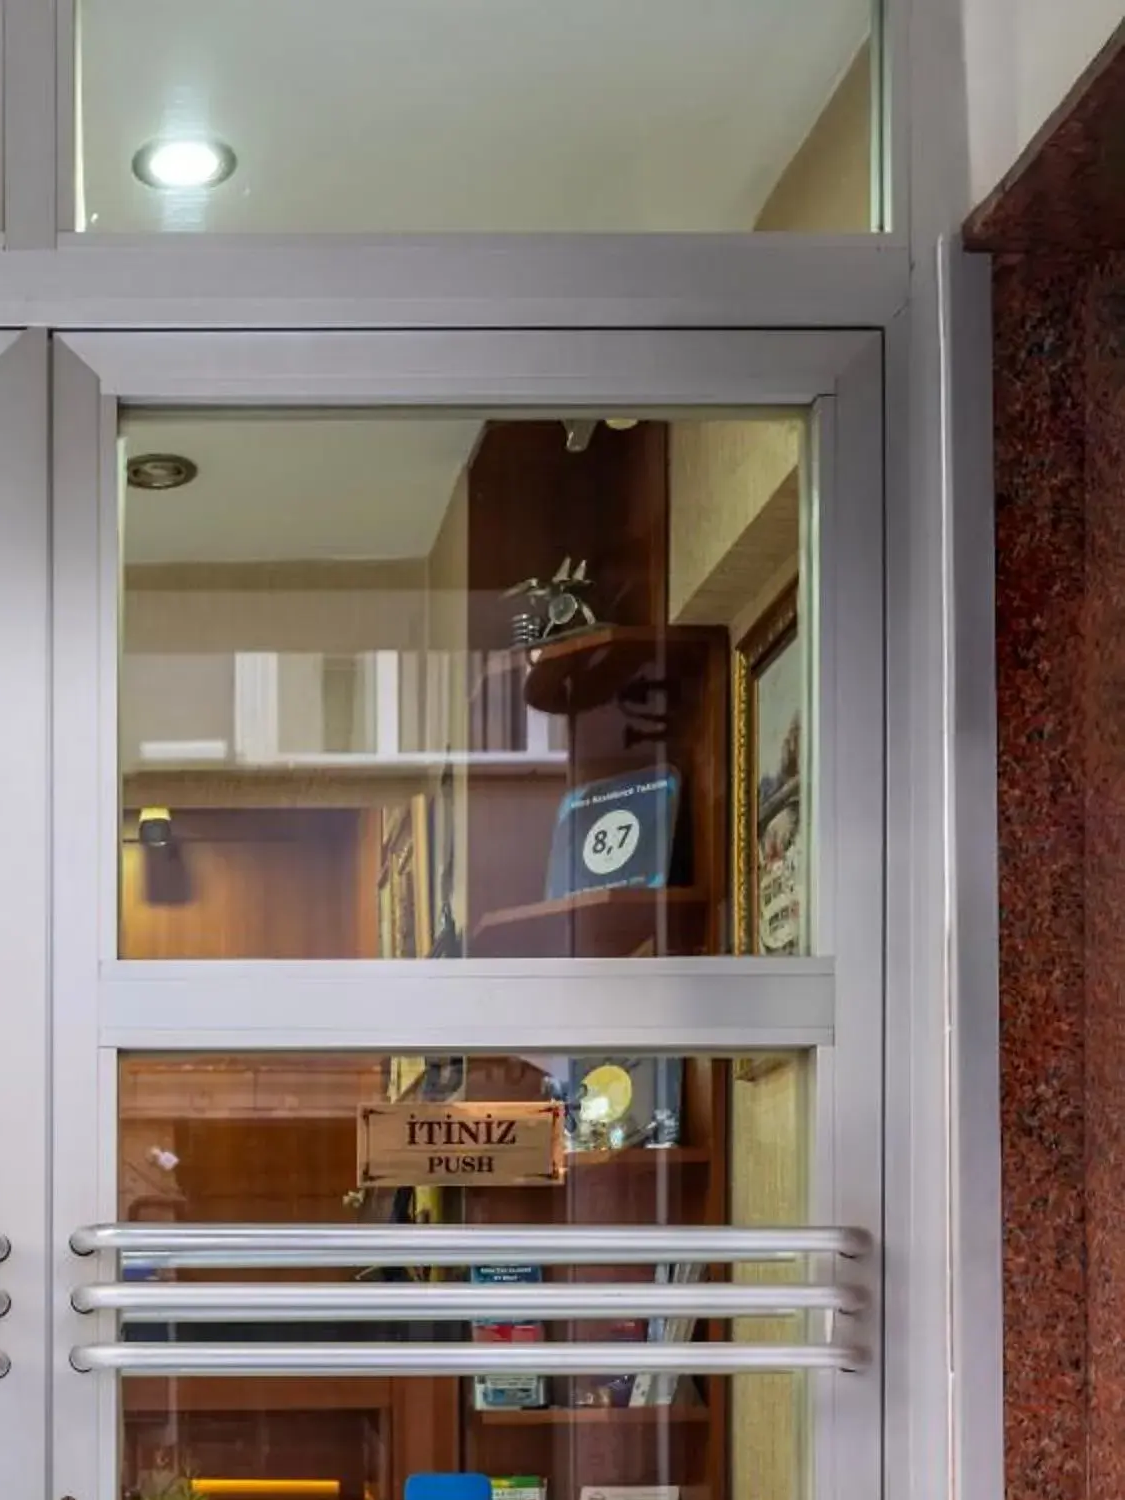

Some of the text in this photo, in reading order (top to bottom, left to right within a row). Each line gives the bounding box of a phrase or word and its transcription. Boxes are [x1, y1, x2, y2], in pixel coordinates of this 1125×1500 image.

[592, 823, 633, 856] 8,7
[406, 1113, 517, 1146] İTİNİZ
[427, 1155, 494, 1174] PUSH
